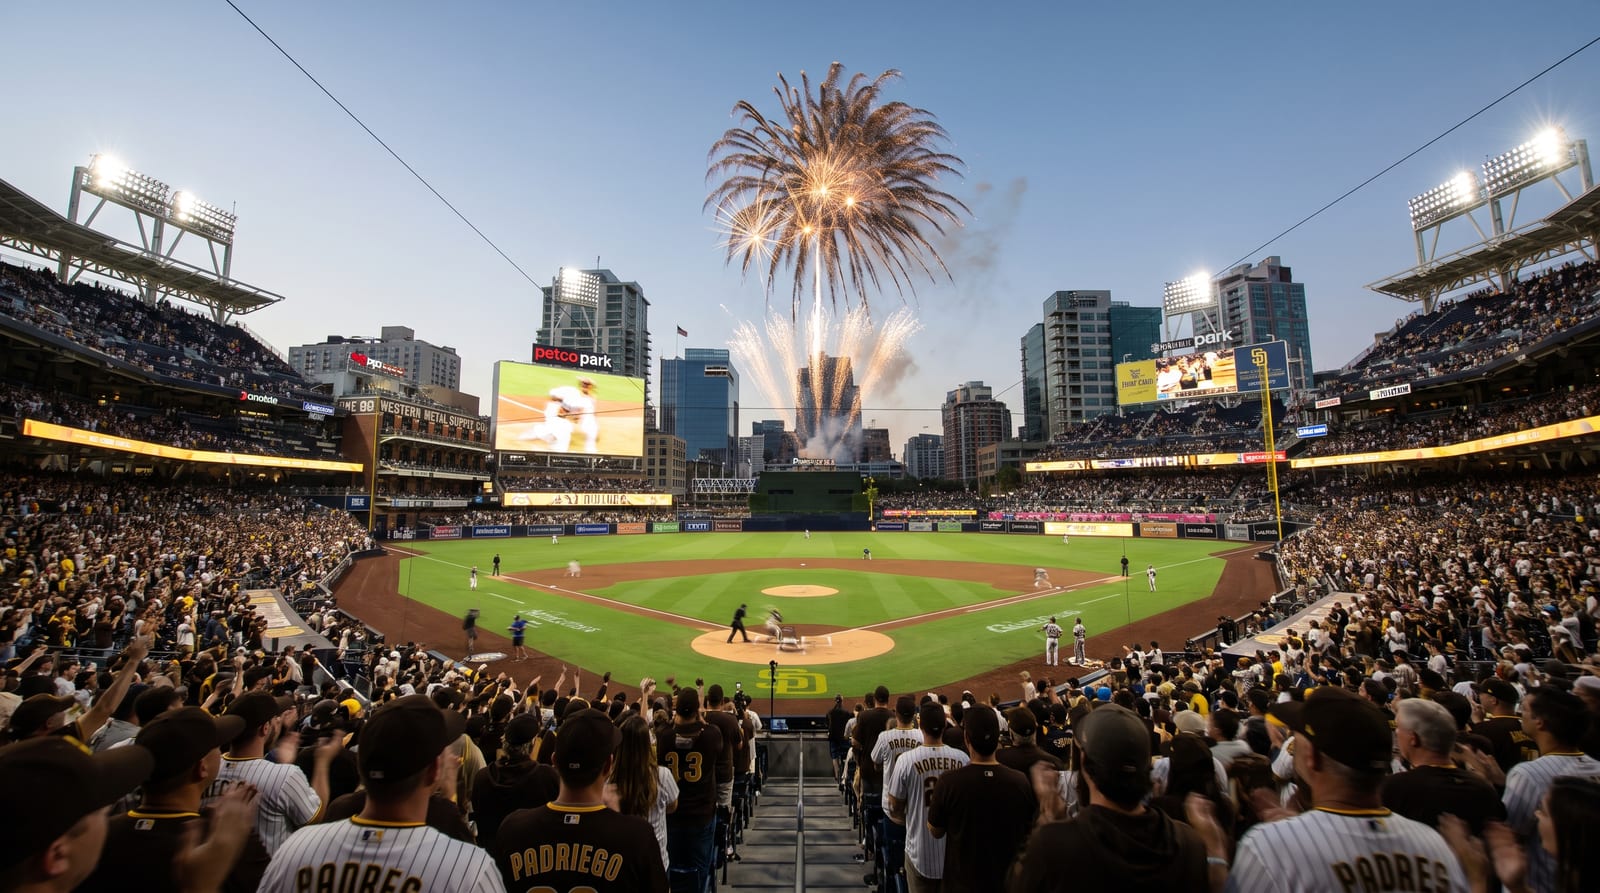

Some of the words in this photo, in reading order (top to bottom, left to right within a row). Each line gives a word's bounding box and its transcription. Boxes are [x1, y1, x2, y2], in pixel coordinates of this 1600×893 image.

[1194, 329, 1234, 349] park
[535, 347, 579, 363] petco
[580, 354, 612, 368] park
[380, 399, 421, 419] WESTERN
[423, 411, 449, 425] METAL
[509, 842, 623, 882] PADRIEGO
